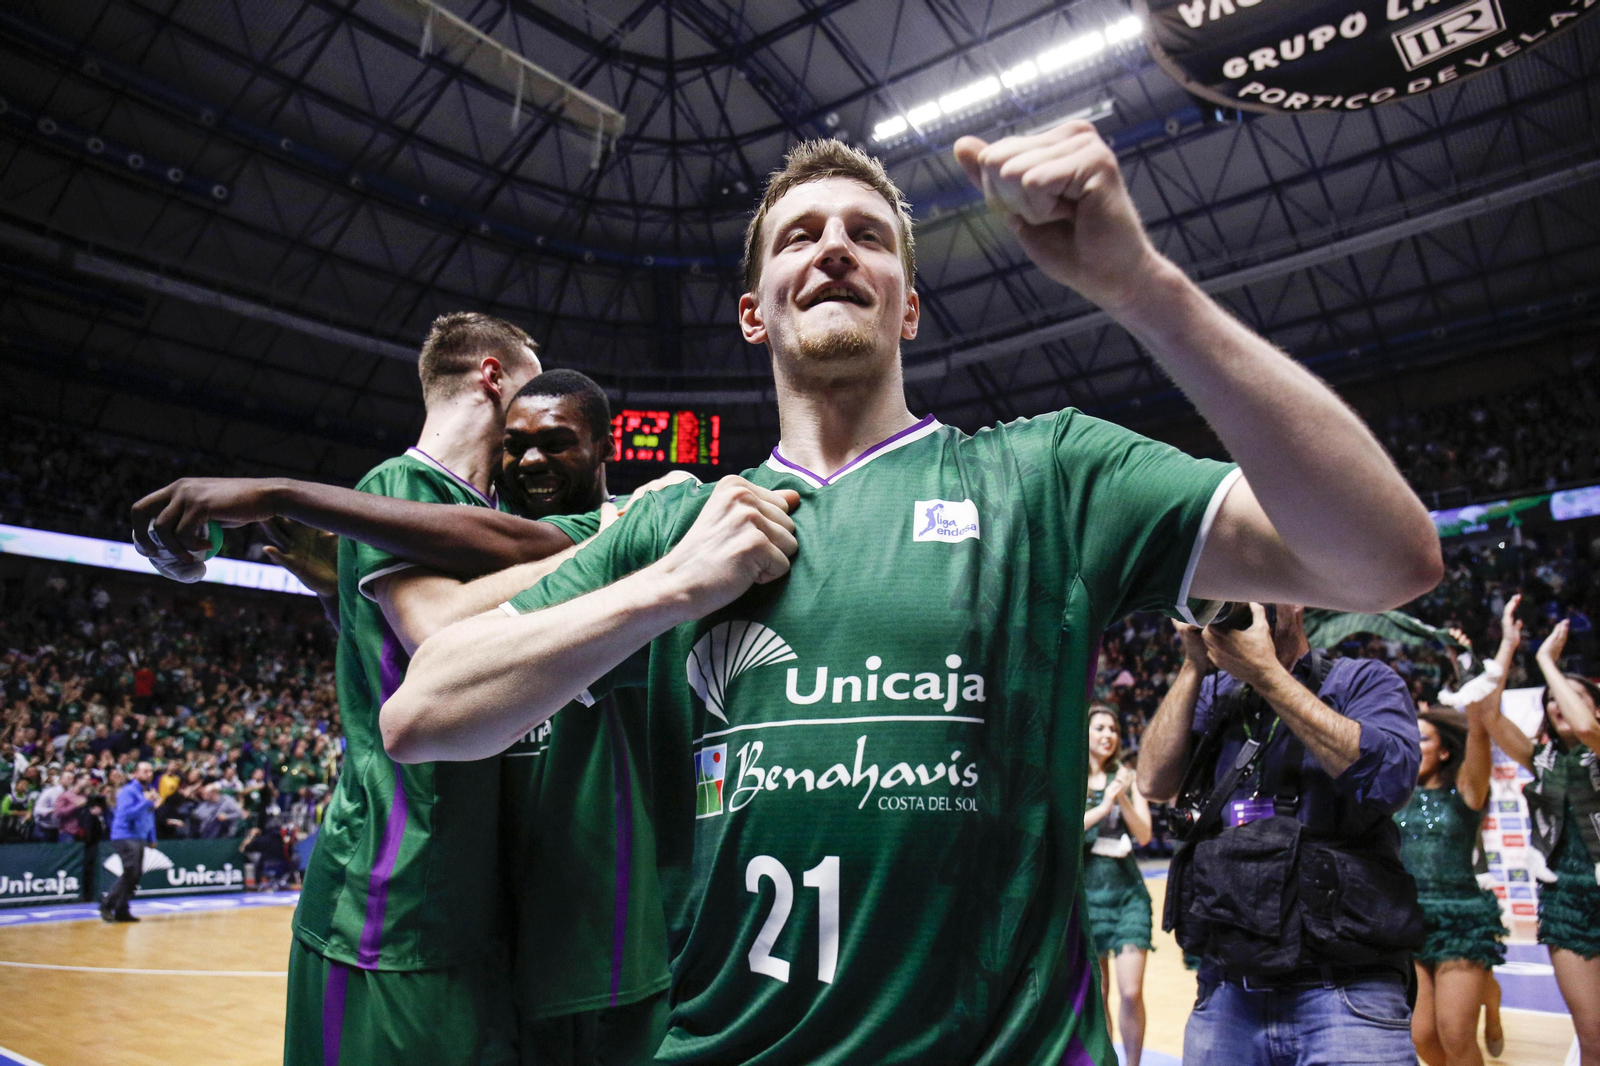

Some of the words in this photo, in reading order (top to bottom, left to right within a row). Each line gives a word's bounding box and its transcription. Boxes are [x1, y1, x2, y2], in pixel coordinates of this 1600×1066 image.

[1223, 11, 1367, 79] GRUPO
[1238, 81, 1397, 110] PORTICO
[936, 512, 957, 528] liga
[785, 654, 987, 712] Unicaja
[877, 796, 926, 811] COSTA
[928, 796, 953, 811] DEL
[955, 797, 979, 812] SOL
[167, 863, 243, 887] Unicaja
[745, 854, 840, 984] 21
